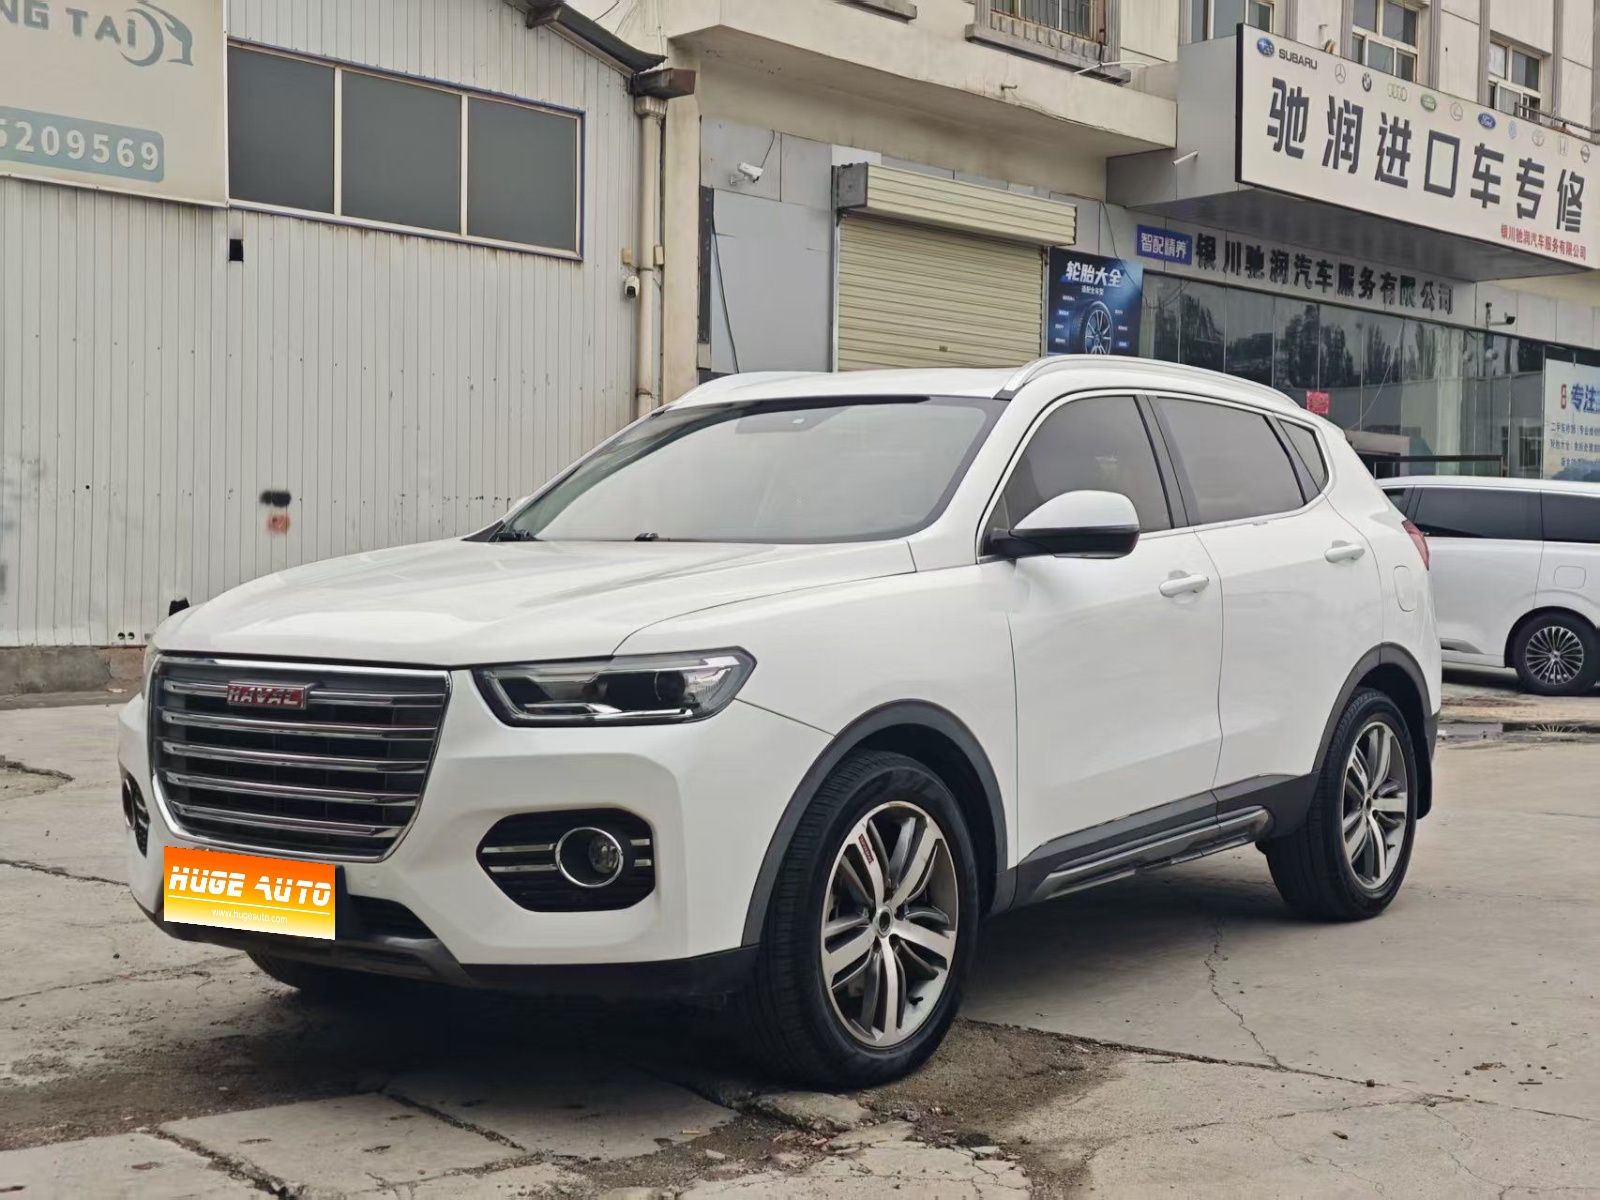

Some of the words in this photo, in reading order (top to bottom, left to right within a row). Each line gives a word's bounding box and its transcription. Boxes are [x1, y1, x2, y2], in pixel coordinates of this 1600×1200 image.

[1279, 48, 1318, 70] SUBARU
[1267, 77, 1586, 233] 驰润进口车专修
[1141, 232, 1187, 259] 智配精养
[1500, 223, 1587, 261] 银川驰润汽车服务有限公司
[1065, 260, 1122, 288] 轮胎大全
[1196, 232, 1454, 315] 银川驰润汽车服务有限公司
[1571, 383, 1600, 414] 专注
[228, 686, 298, 704] HAVAL
